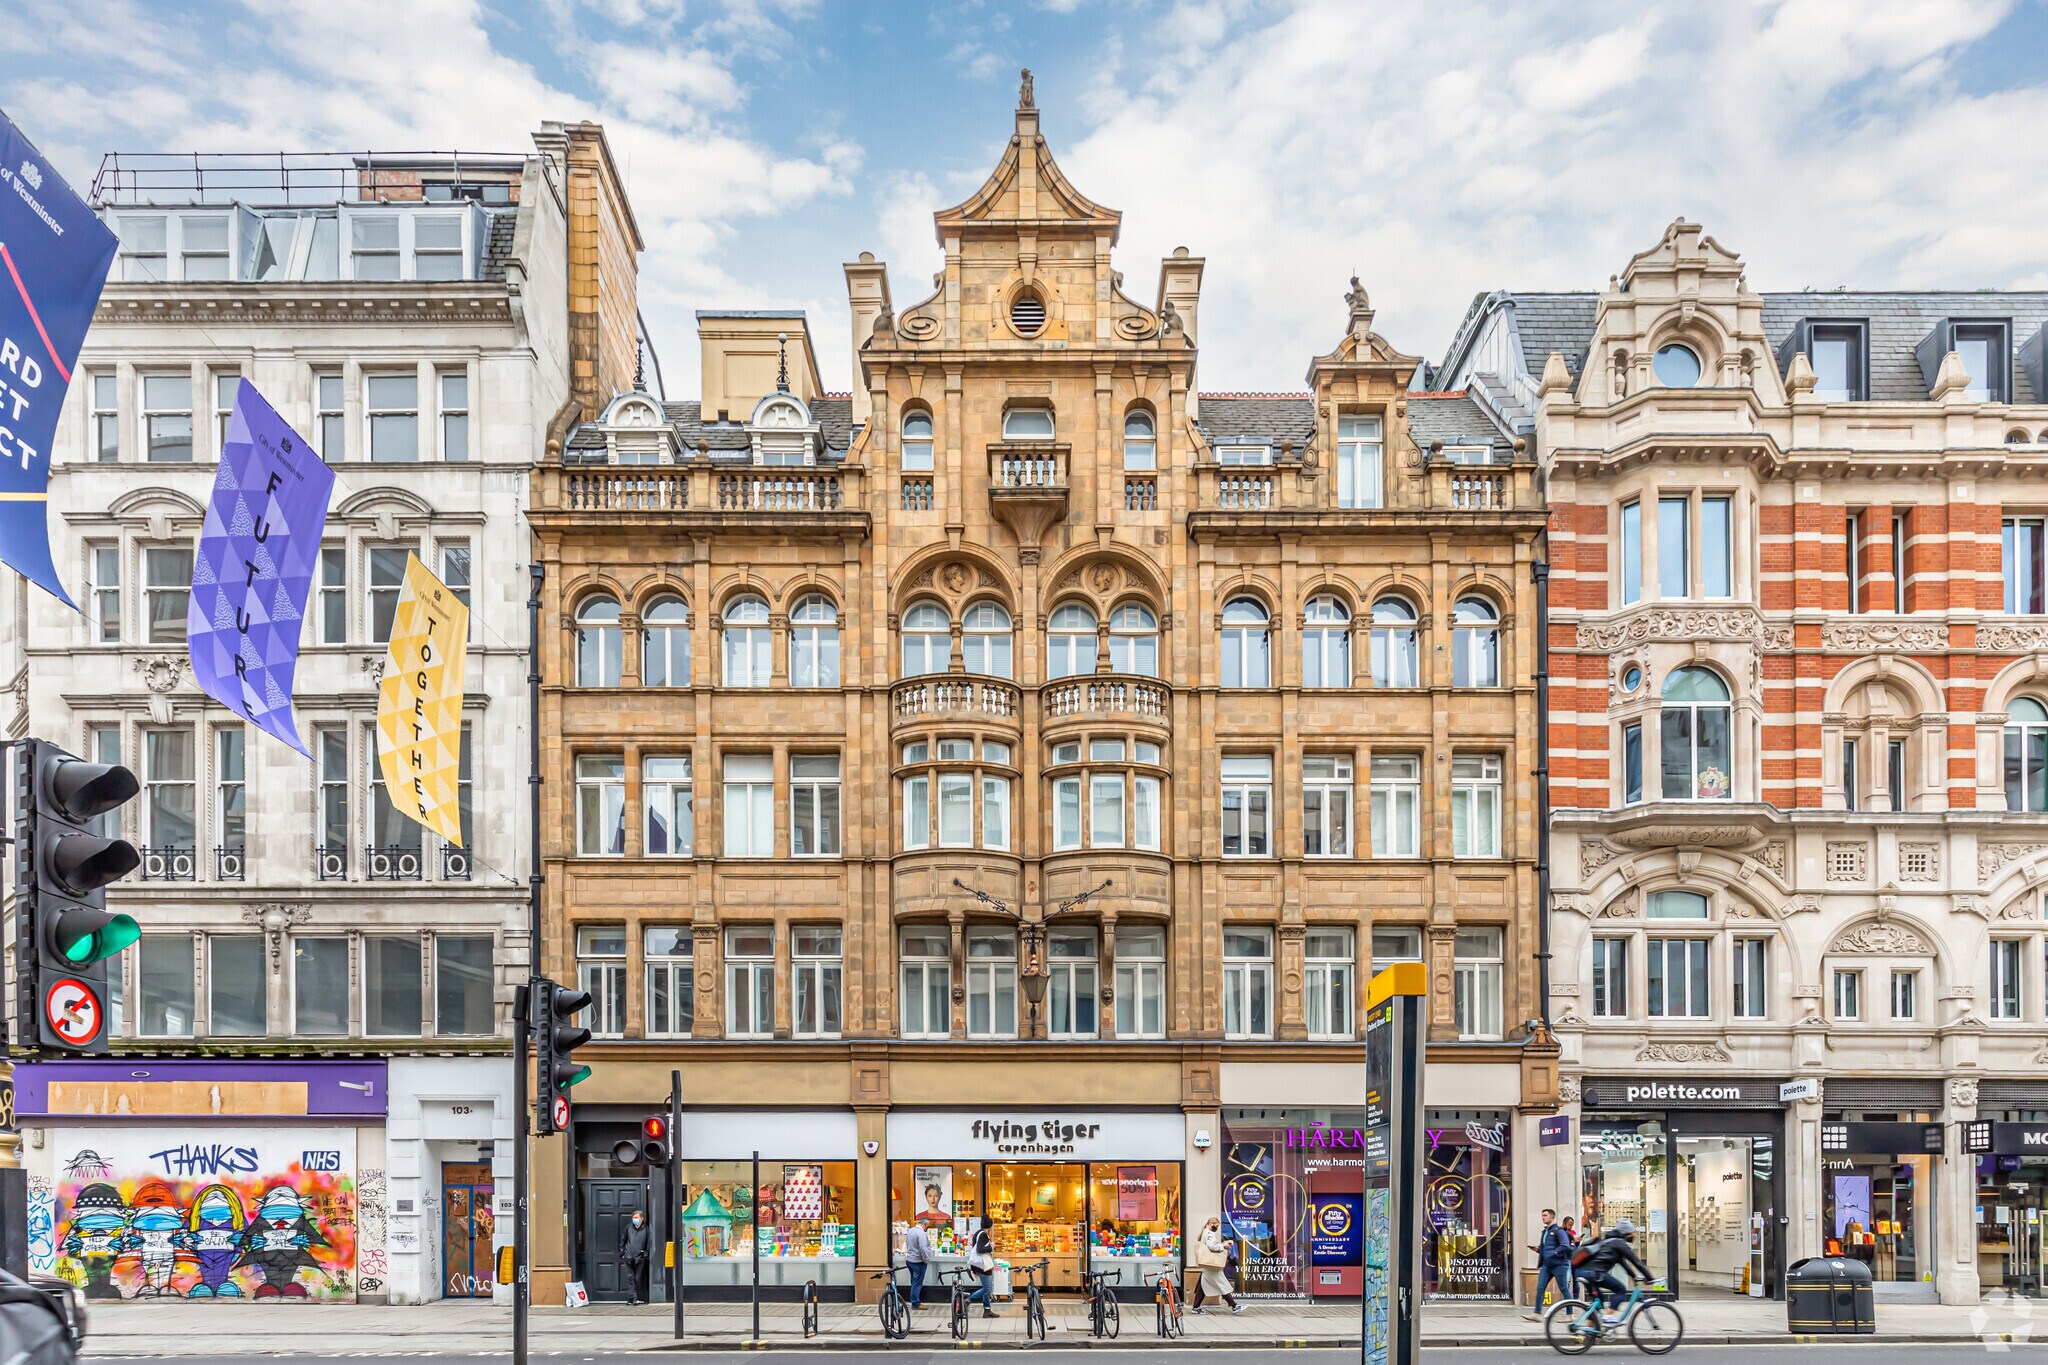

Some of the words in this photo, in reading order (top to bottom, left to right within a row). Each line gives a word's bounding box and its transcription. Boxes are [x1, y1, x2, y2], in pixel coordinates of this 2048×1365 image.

[1, 167, 13, 182] of
[13, 176, 64, 237] Westminster
[258, 433, 271, 450] City
[276, 450, 305, 482] Westminster
[234, 470, 282, 726] FUTURE
[411, 616, 437, 821] TOGETHER
[1627, 1082, 1741, 1102] polette.com
[1783, 1084, 1807, 1096] polette
[971, 1119, 1037, 1143] flying
[1041, 1119, 1100, 1143] tiger
[1601, 1129, 1644, 1150] Stop
[998, 1143, 1074, 1155] copenhagen
[1601, 1148, 1645, 1160] getting
[149, 1143, 259, 1176] THANKS
[303, 1151, 339, 1171] NHS
[1722, 1171, 1743, 1183] polette
[1120, 1184, 1151, 1194] 50%
[1307, 1203, 1351, 1237] 10
[1242, 1257, 1288, 1265] DISCOVER
[1449, 1258, 1492, 1267] DISCOVER
[1235, 1265, 1260, 1273] YOUR
[1261, 1265, 1296, 1273] EROTIC
[1439, 1266, 1464, 1275] YOUR
[1465, 1266, 1501, 1275] EROTIC
[1244, 1273, 1286, 1281] FANTASY
[1448, 1274, 1491, 1283] FANTASY
